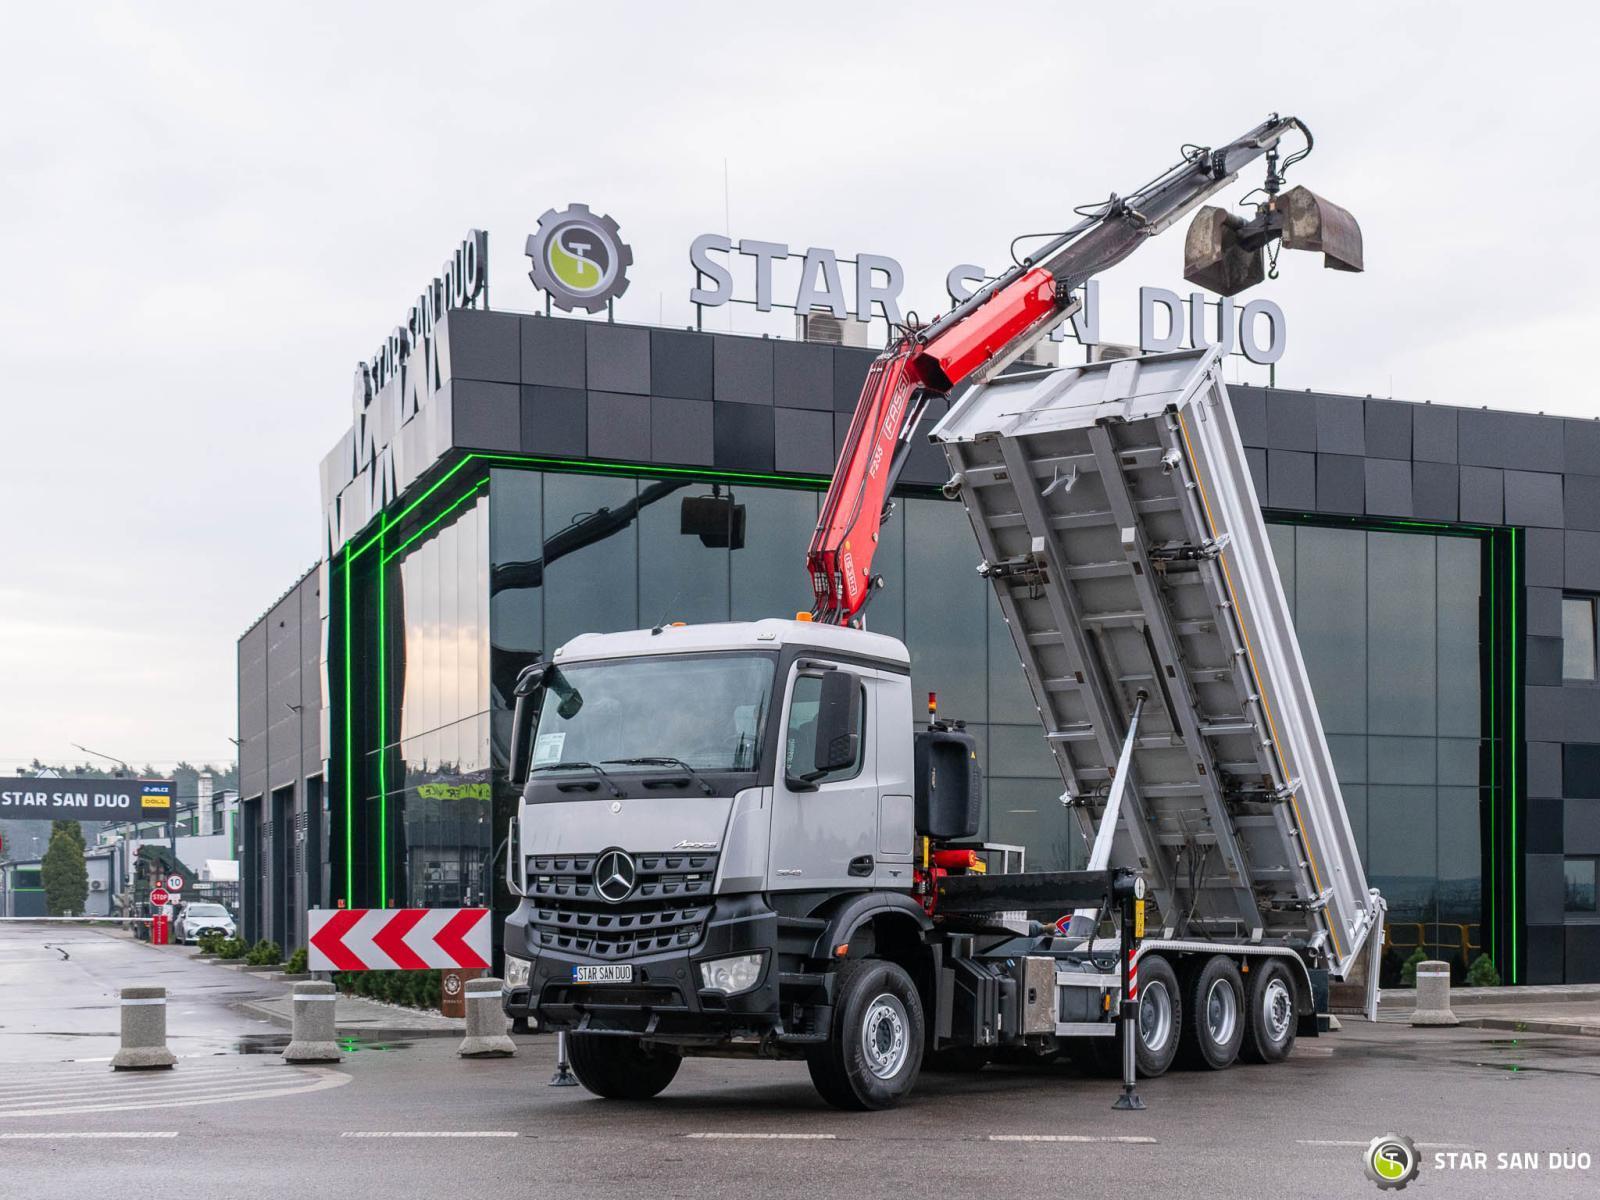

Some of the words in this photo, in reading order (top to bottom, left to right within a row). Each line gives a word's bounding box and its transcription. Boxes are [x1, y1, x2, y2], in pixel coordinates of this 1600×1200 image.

[442, 228, 485, 316] DUO
[690, 234, 904, 325] STAR
[946, 264, 1099, 345] SN
[1139, 286, 1286, 365] DUO
[884, 370, 910, 436] FASSI
[2, 792, 47, 806] STAR
[53, 793, 88, 807] SAN
[94, 794, 130, 808] DUO
[170, 879, 180, 887] 10
[578, 967, 597, 980] STAR
[600, 966, 614, 980] SAN
[616, 966, 631, 979] DUO
